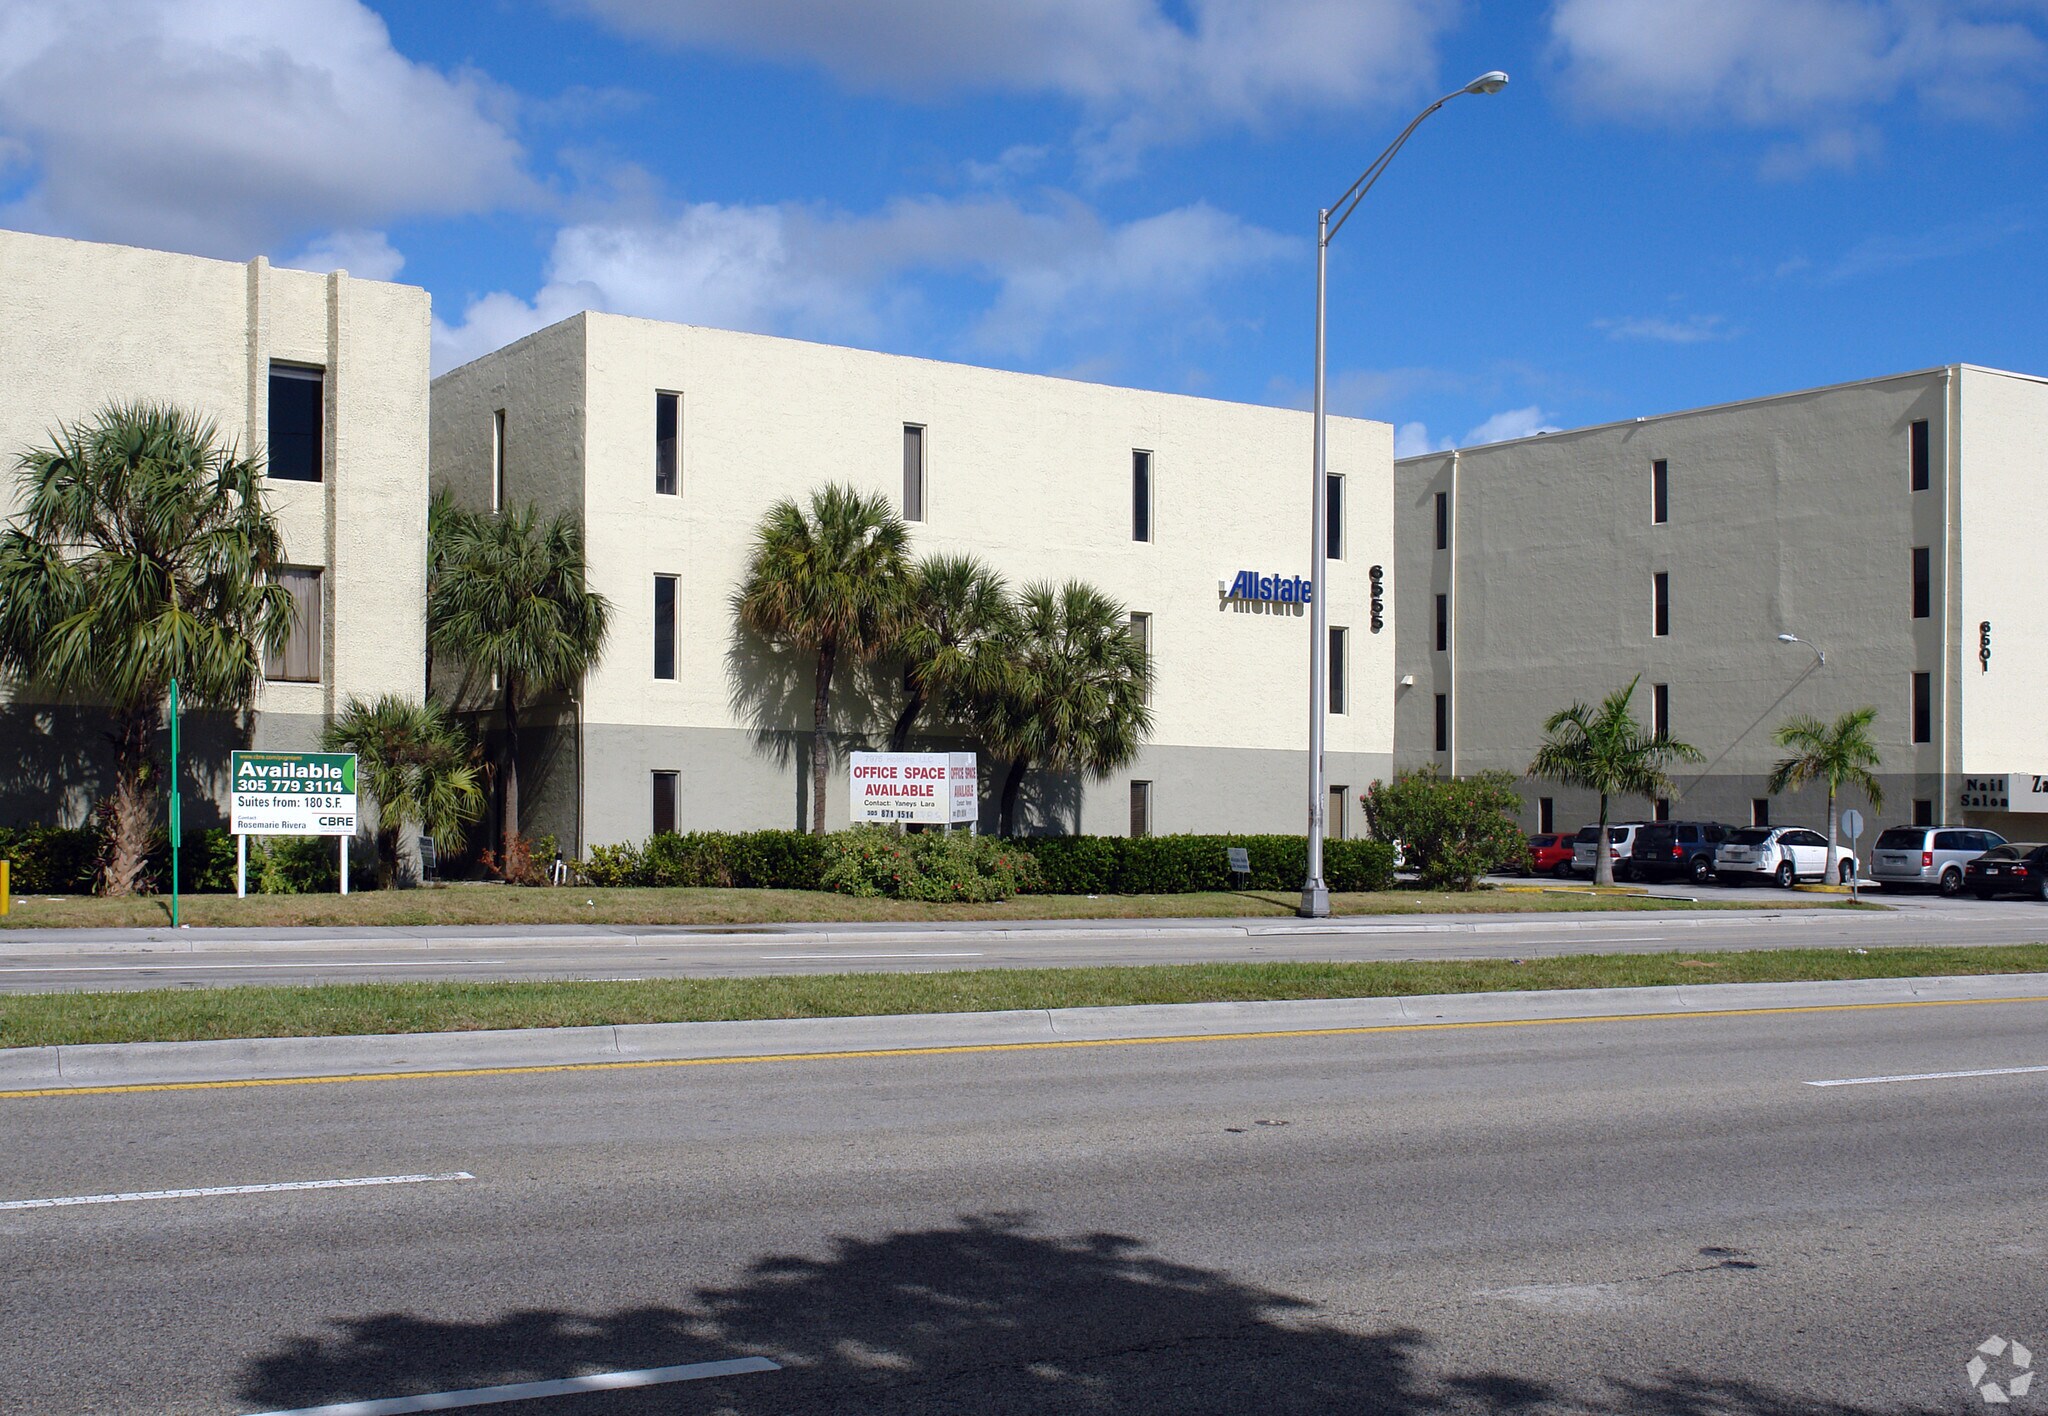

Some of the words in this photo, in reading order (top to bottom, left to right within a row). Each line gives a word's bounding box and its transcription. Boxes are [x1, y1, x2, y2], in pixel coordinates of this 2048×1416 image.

[1229, 570, 1312, 604] Allstate
[1369, 565, 1384, 630] 6555
[1979, 621, 1991, 672] 6501
[238, 761, 343, 779] Available
[853, 766, 897, 779] OFFICE
[904, 767, 946, 780] SPACE
[238, 779, 267, 792] 305
[271, 780, 301, 792] 779
[304, 781, 343, 793] 3114
[865, 784, 934, 797] AVAILABLE
[1966, 778, 2004, 792] Nail
[238, 796, 270, 808] Suites
[273, 797, 300, 808] from:
[304, 797, 323, 808] 180
[325, 798, 342, 809] S.F.
[864, 799, 892, 807] Contact:
[920, 800, 935, 808] Lara
[1961, 794, 2009, 807] Salon
[881, 809, 894, 818] 871
[897, 810, 914, 819] 1514
[238, 820, 280, 829] Rosemarie
[281, 820, 307, 829] Rivera
[319, 816, 354, 826] CBRE
